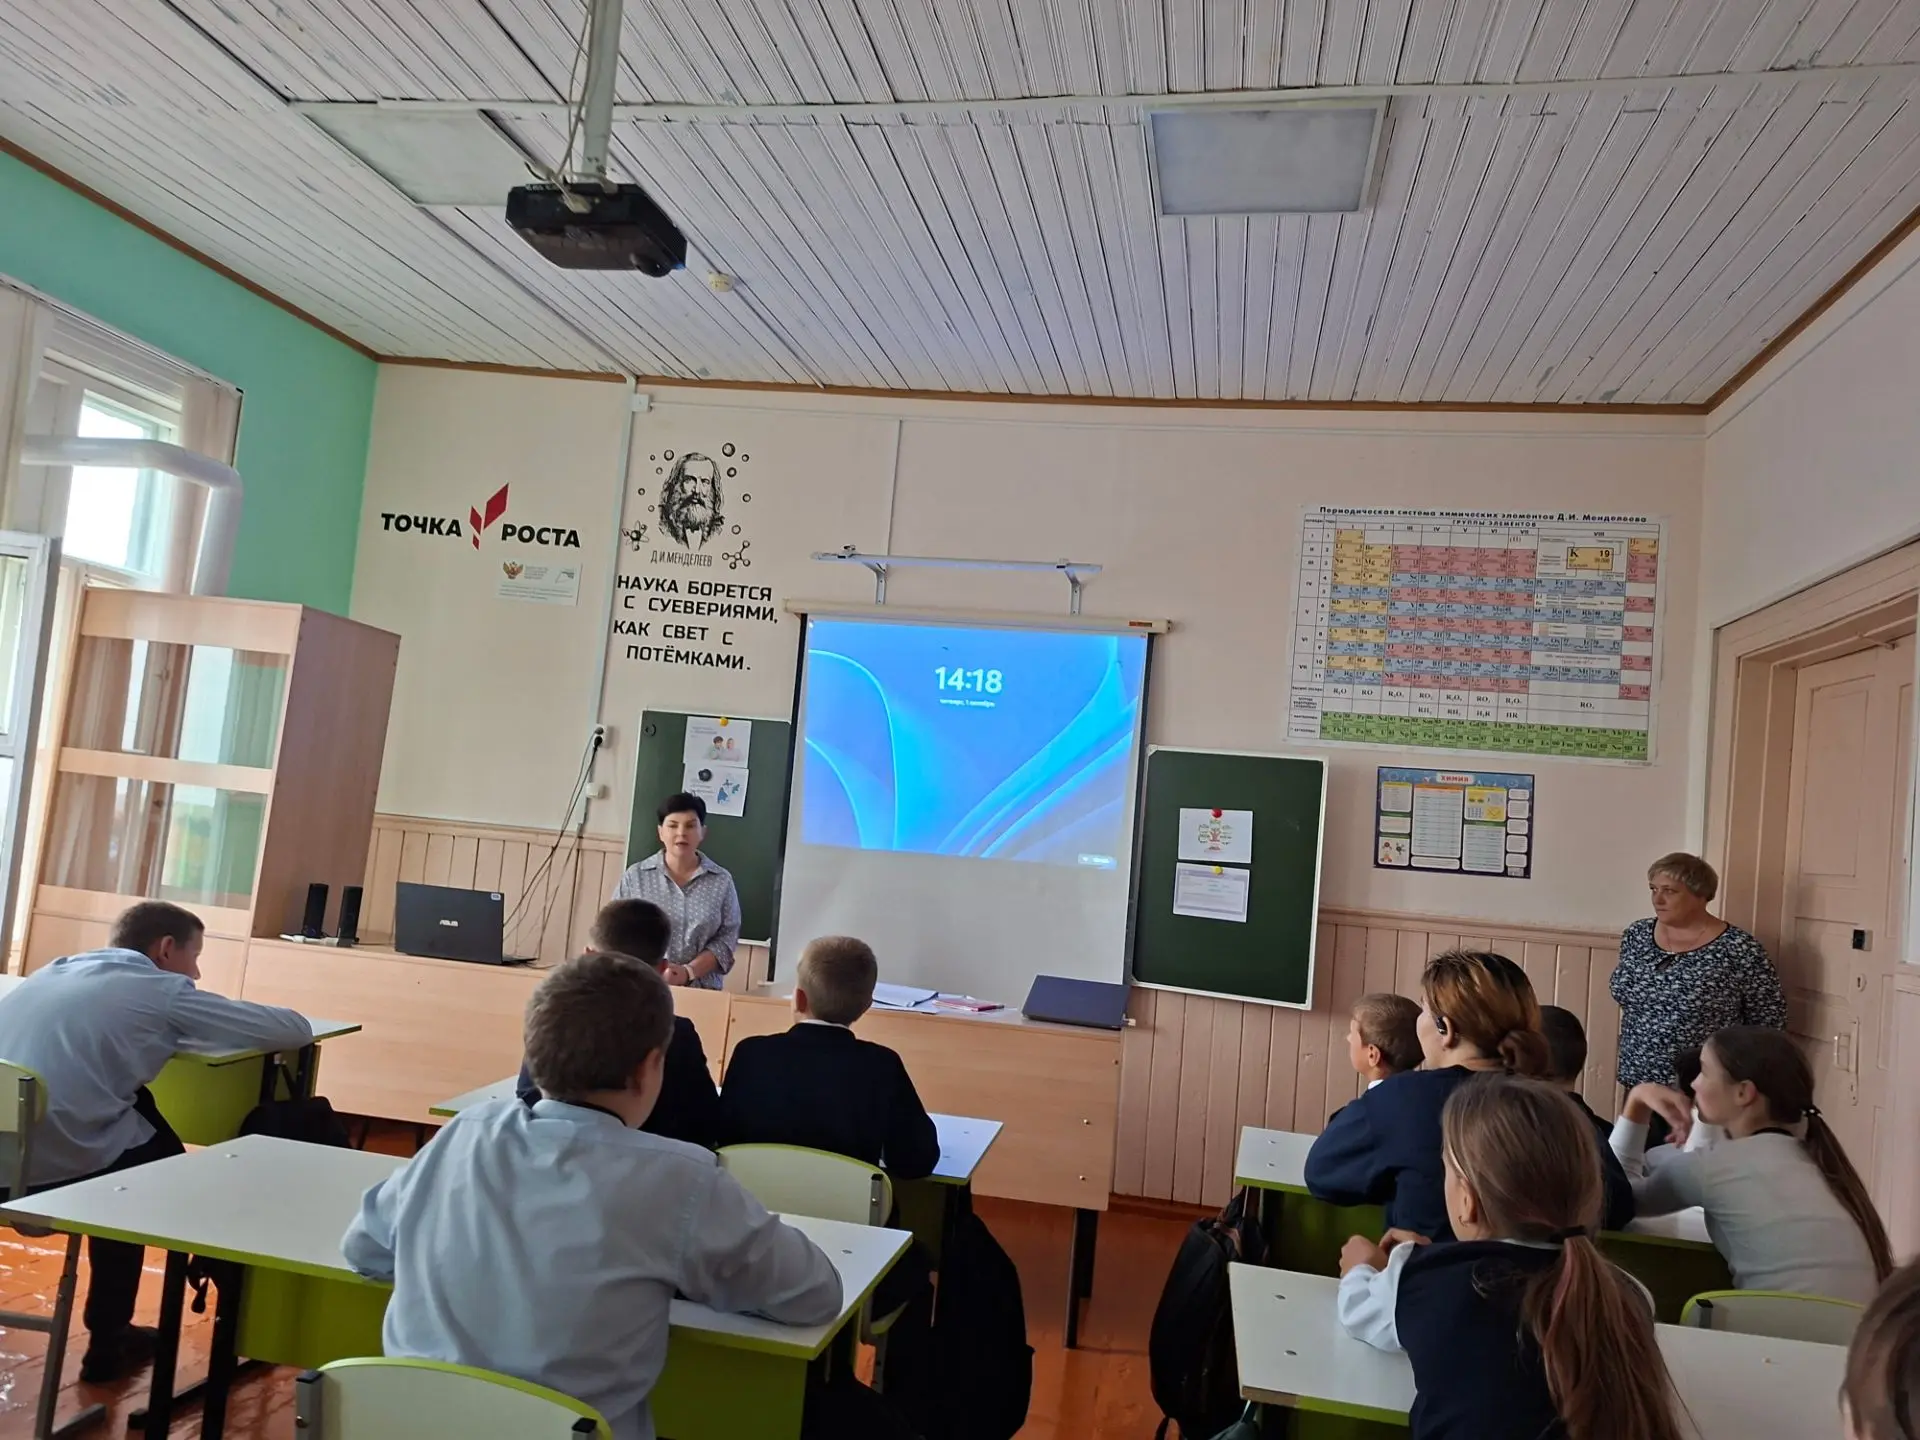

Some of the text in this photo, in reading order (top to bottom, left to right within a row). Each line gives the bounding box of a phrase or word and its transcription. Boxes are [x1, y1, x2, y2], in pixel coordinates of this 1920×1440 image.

[381, 513, 580, 548] ТОЧКА РОСТА
[617, 575, 772, 601] НАУКА БОРЕТСЯ
[624, 596, 778, 624] С СУЕВЕРИЯМИ,
[613, 620, 734, 645] КАК СВЕТ С
[626, 645, 751, 670] ПОТЁМКАМИ.
[935, 666, 1003, 693] 14:18
